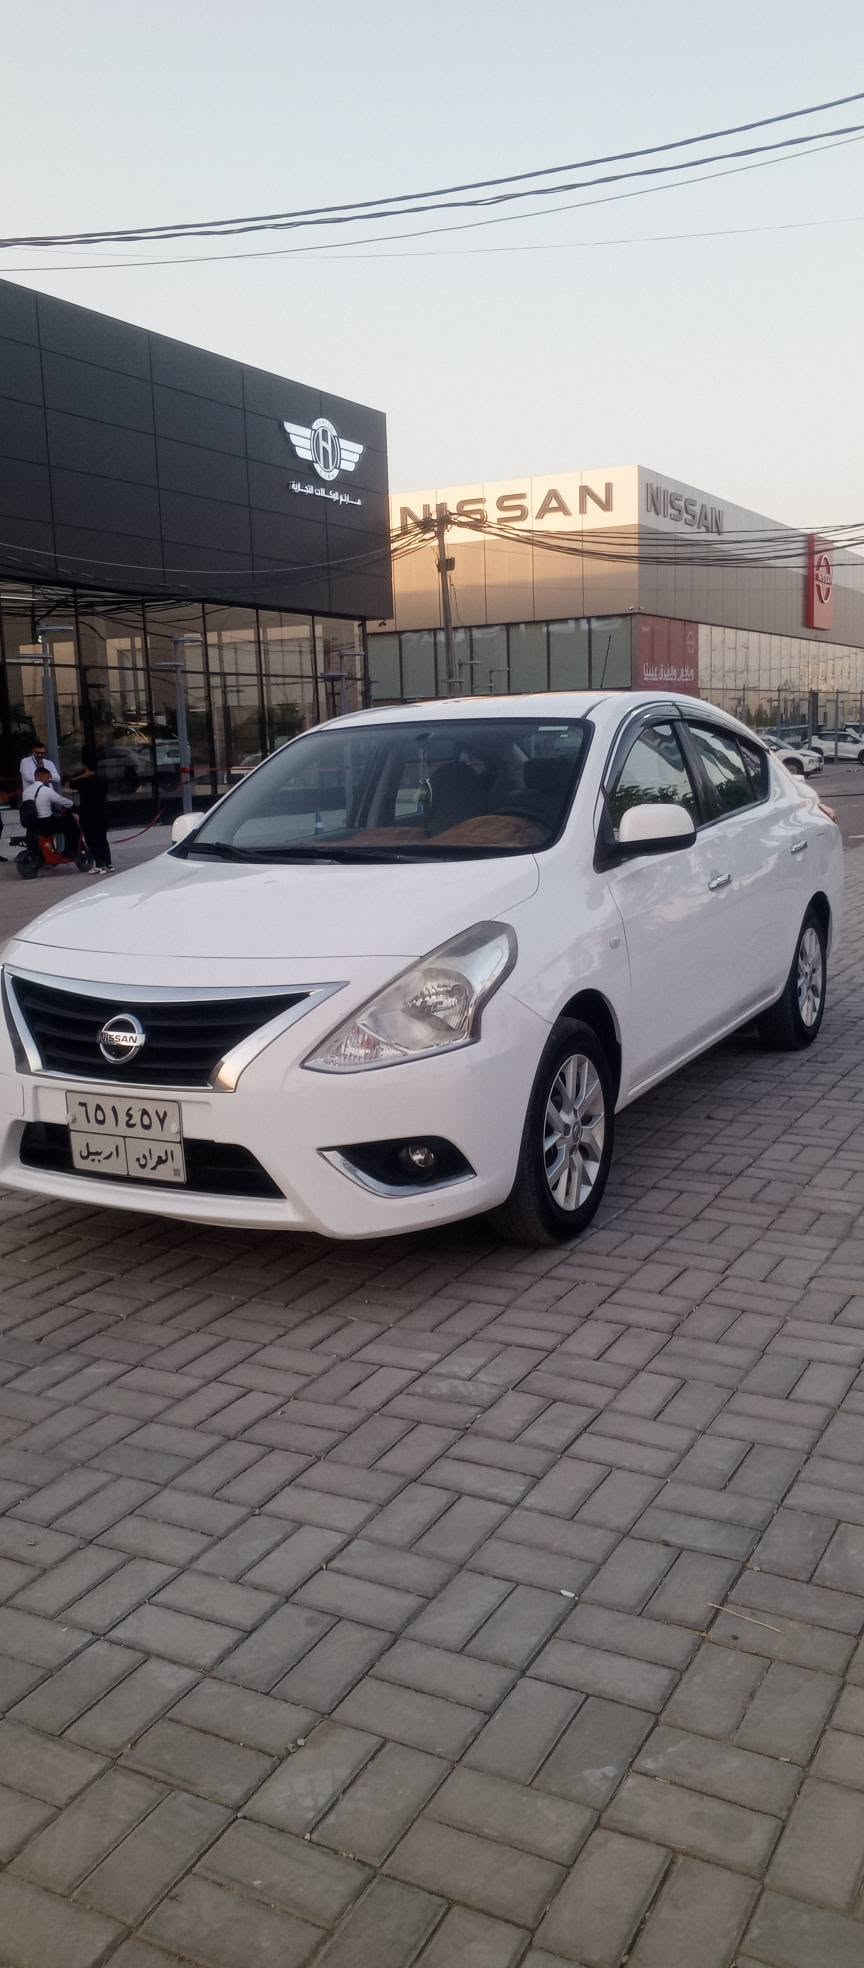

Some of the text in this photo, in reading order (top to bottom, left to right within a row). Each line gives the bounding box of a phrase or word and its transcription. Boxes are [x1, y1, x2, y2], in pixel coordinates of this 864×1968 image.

[400, 482, 613, 535] NISSAN
[646, 483, 724, 535] NISSAN
[101, 1032, 138, 1043] NISSAN
[78, 1101, 168, 1132] ٦٥١٤٥٧
[136, 1148, 175, 1171] العراق
